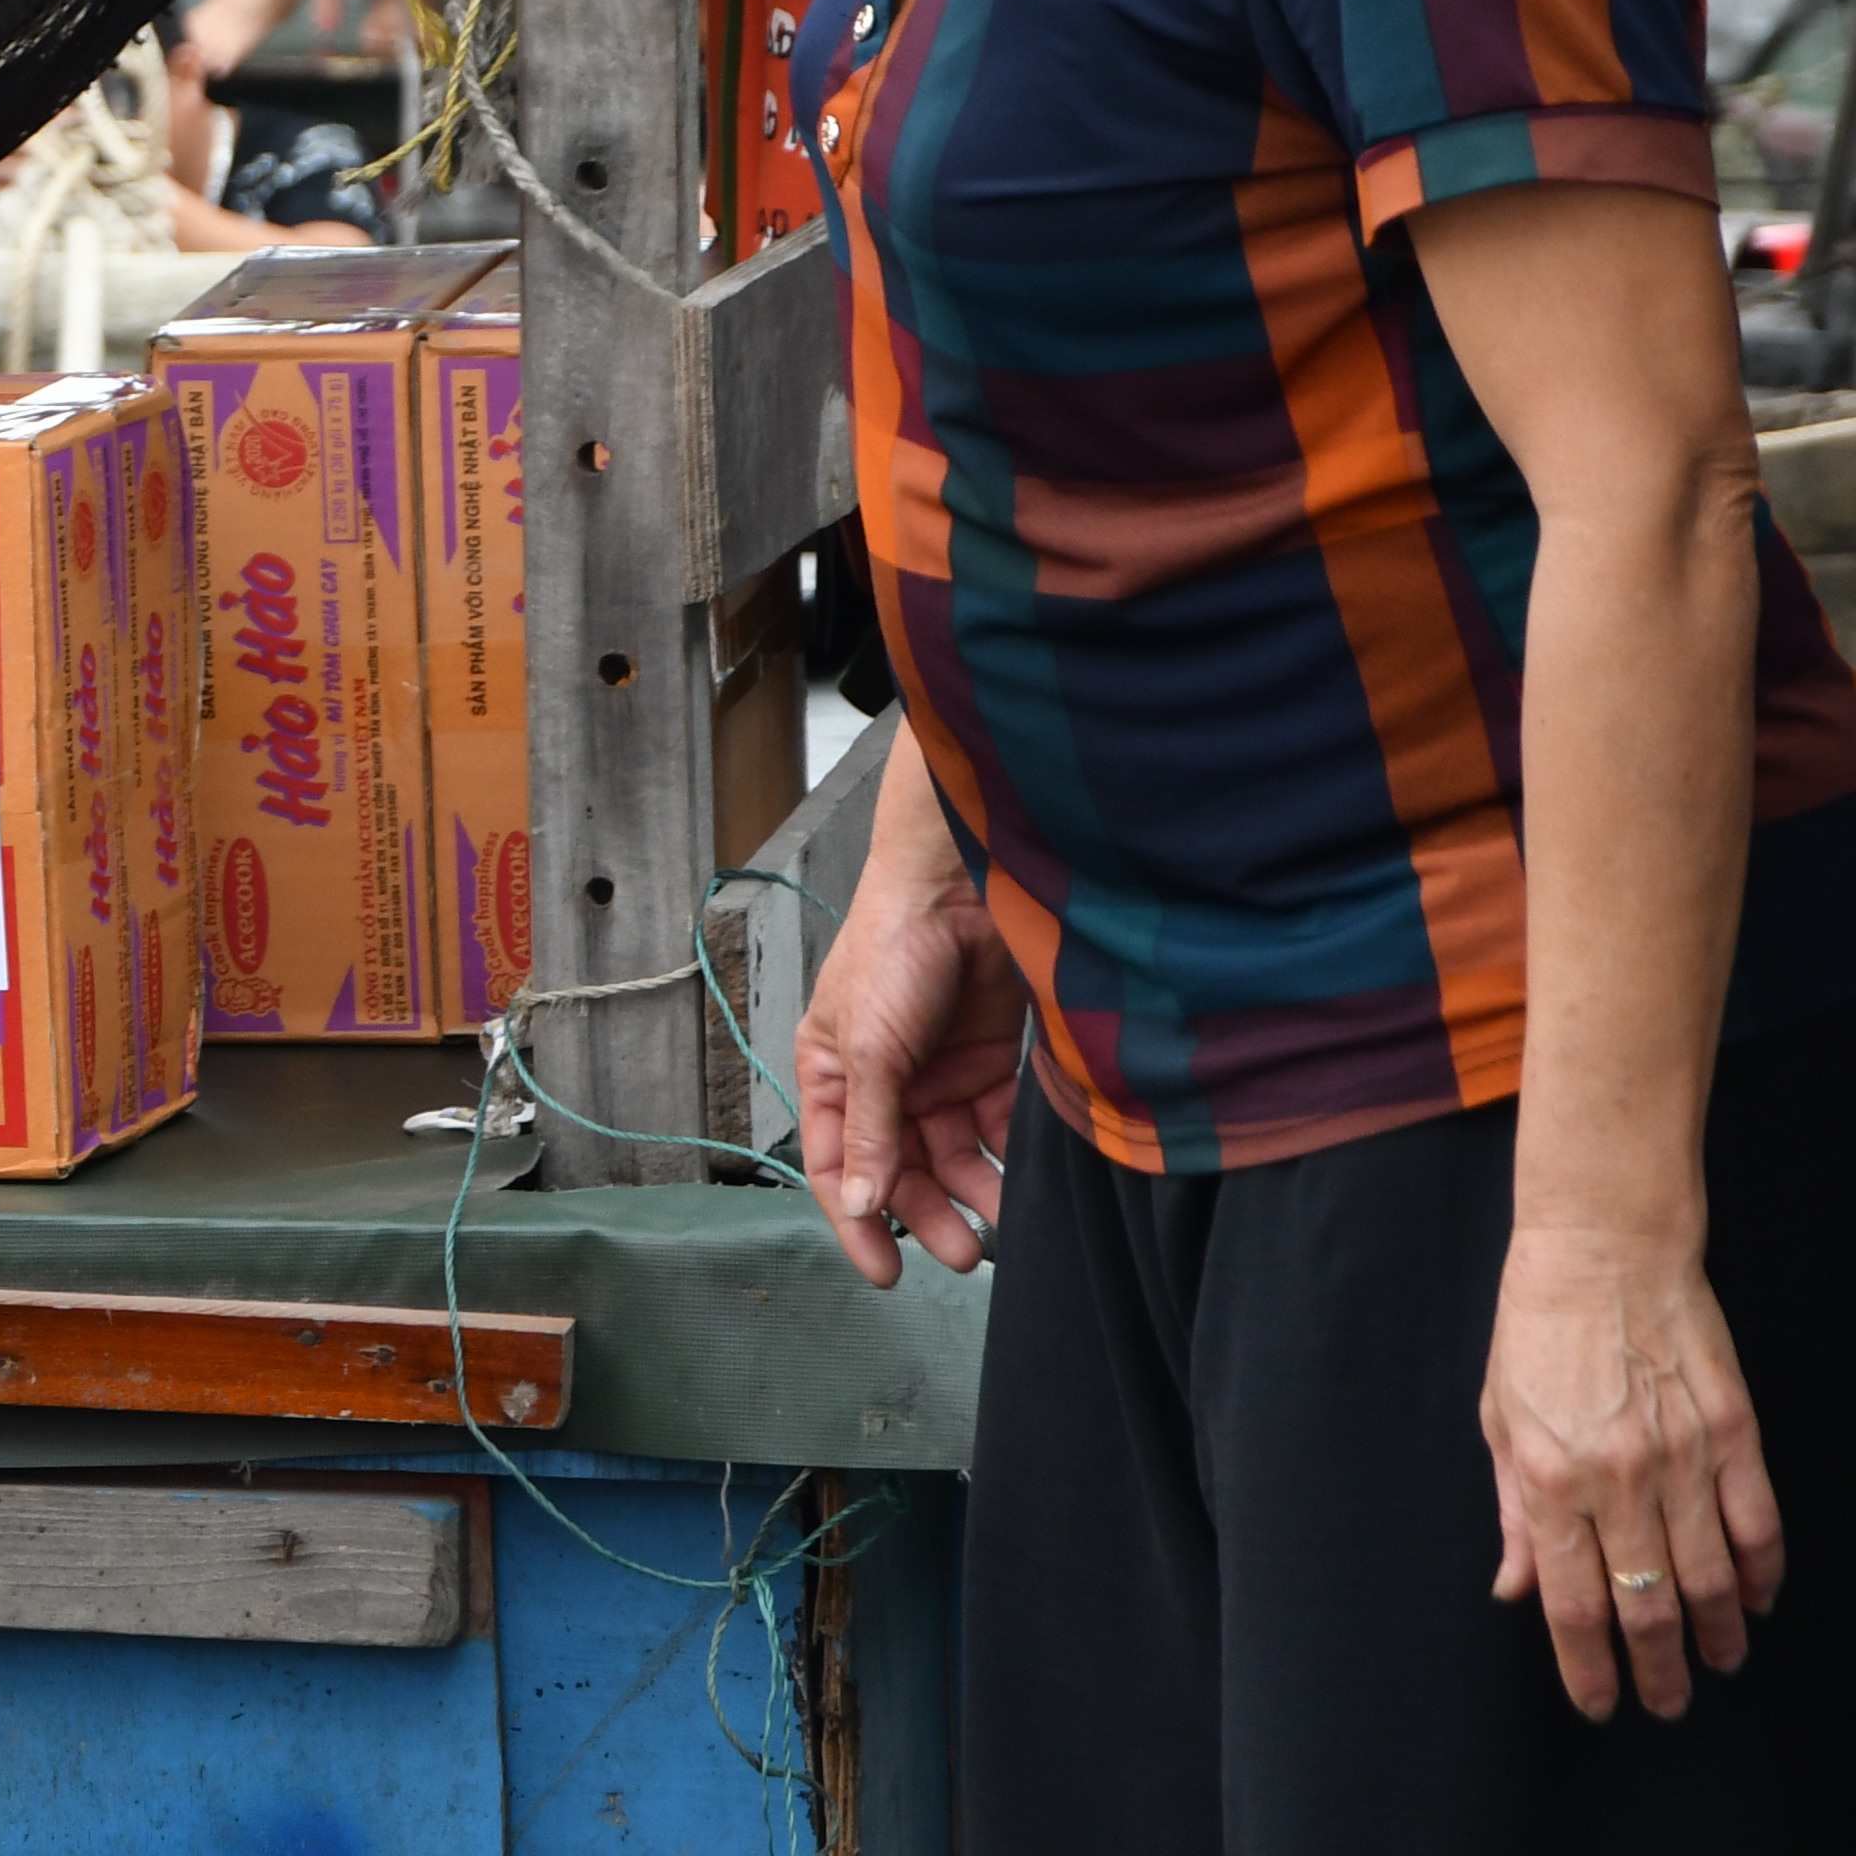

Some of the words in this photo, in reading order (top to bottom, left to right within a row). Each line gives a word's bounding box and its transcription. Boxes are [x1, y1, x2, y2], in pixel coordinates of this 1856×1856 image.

[183, 390, 204, 427] BẢN
[455, 385, 477, 422] BẢN
[457, 427, 481, 475] NHẬT
[458, 480, 482, 530] NGHỆ
[464, 535, 483, 586] CÔNG
[218, 552, 308, 684] Hảo
[464, 591, 483, 621] VỚI
[461, 625, 485, 674] PHẨM
[353, 678, 367, 717] NAM
[466, 681, 486, 716] SẢN
[240, 694, 330, 828] Hảo
[356, 769, 375, 853] ACECOOK
[202, 838, 225, 925] happiness
[474, 831, 499, 920] happiness
[205, 932, 229, 977] Cook
[363, 944, 378, 964] TY
[475, 926, 502, 971] Cook
